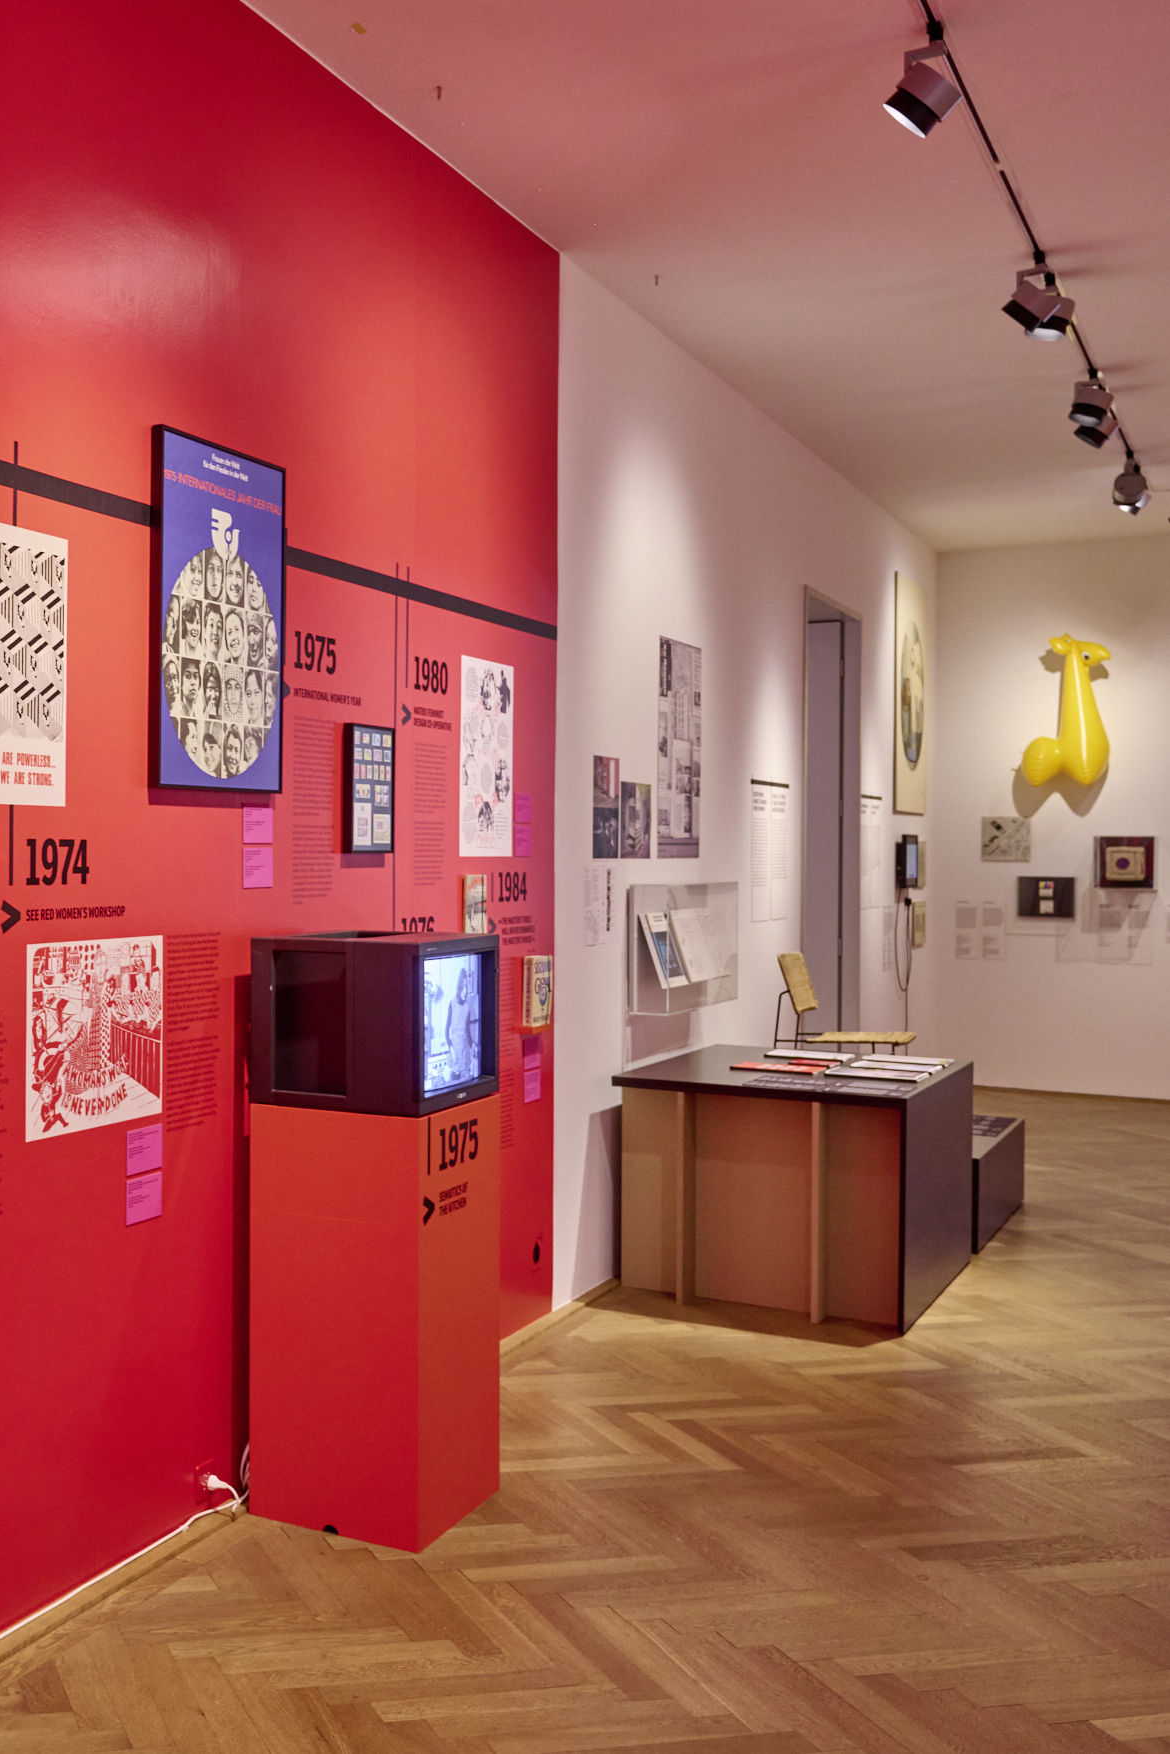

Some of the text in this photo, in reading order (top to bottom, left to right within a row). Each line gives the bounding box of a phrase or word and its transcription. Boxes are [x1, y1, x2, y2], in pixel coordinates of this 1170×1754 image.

[294, 631, 336, 674] 1975
[414, 656, 448, 694] 1980
[2, 752, 13, 765] ARE
[0, 770, 10, 784] WE
[14, 772, 25, 784] ARE
[26, 838, 89, 886] 1974
[499, 872, 526, 902] 1984
[26, 906, 125, 921] SEE RED WOMEN'S WORKSHOP
[440, 1118, 478, 1171] 1975
